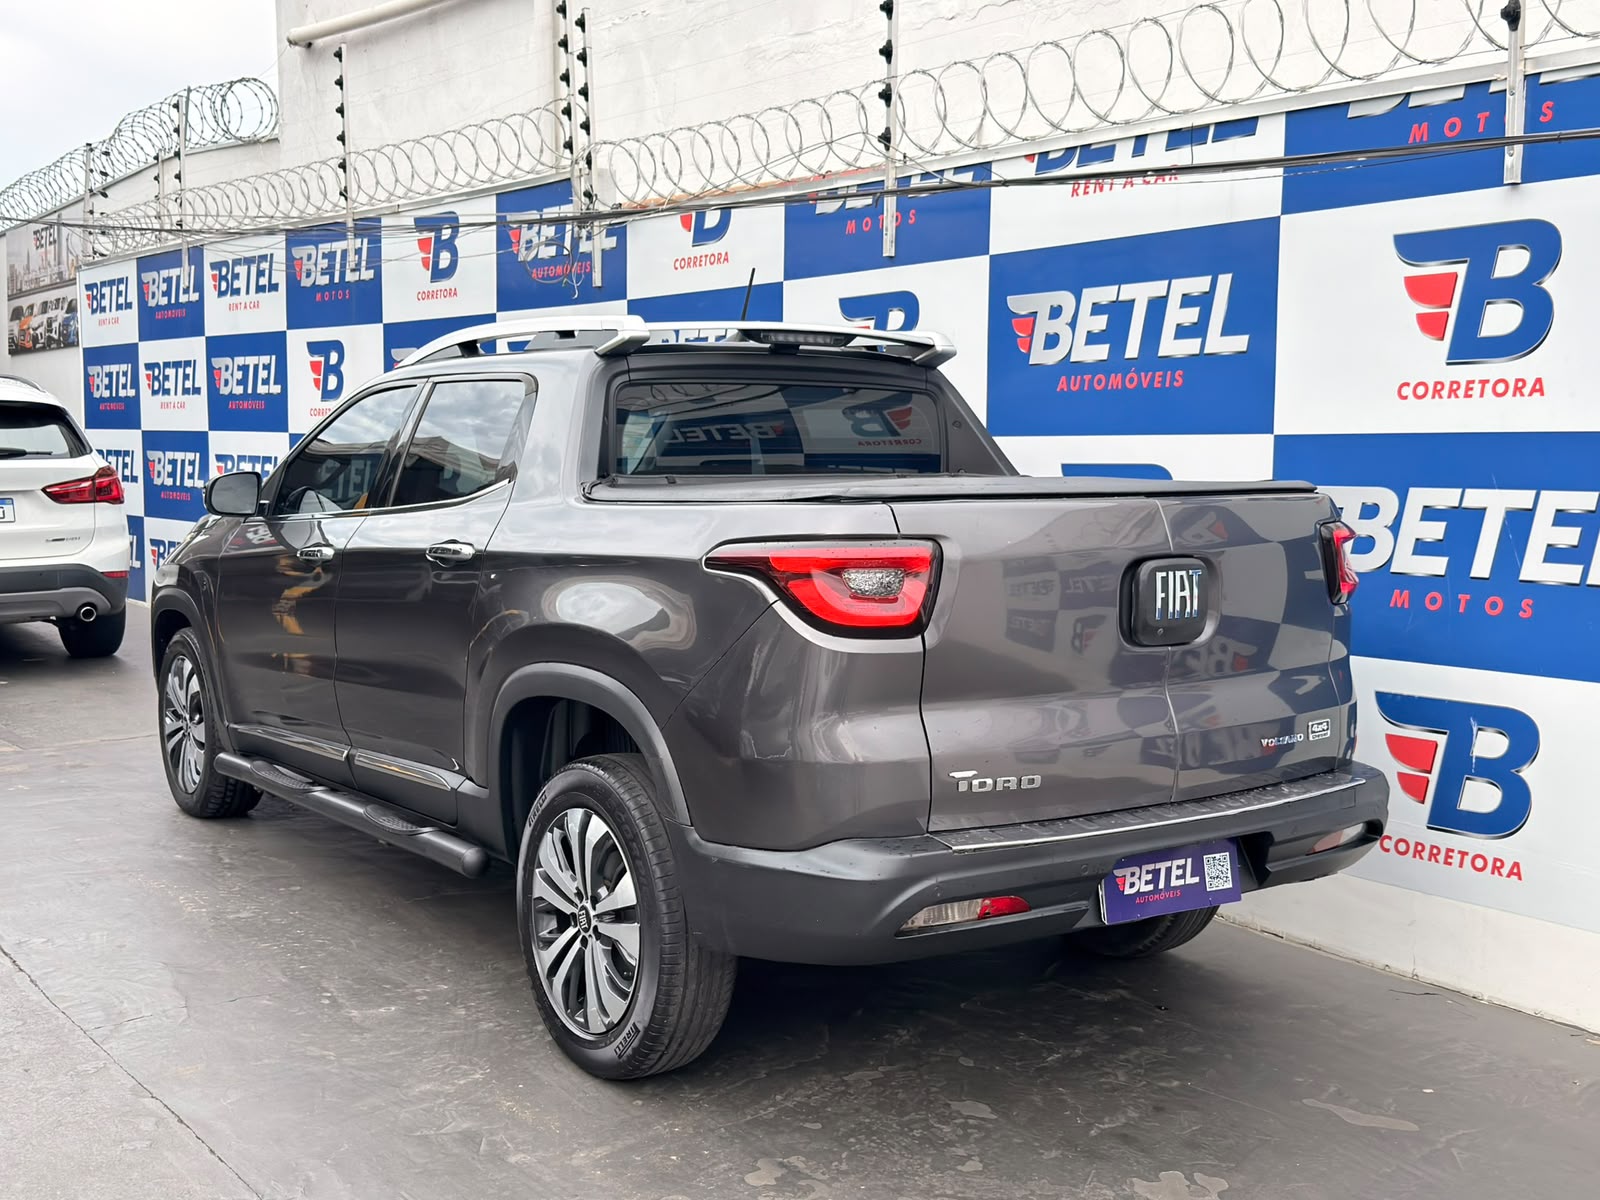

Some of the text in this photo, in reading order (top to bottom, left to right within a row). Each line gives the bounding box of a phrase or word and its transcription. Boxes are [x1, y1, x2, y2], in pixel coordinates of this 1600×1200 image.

[1408, 101, 1554, 144] MOTS
[209, 253, 279, 299] BETEL
[291, 238, 375, 288] BETEL
[673, 251, 729, 271] CORRETORA
[84, 276, 133, 315] BETEL
[315, 289, 351, 302] MOTOS
[416, 287, 458, 301] CORRETORA
[1006, 272, 1250, 366] BETEL
[87, 363, 136, 399] BETEL
[144, 359, 202, 397] BETEL
[211, 355, 282, 395] BETEL
[1056, 367, 1184, 392] AUTOMÓVEIS
[1396, 377, 1546, 401] CORRETORA
[95, 449, 138, 484] TEL
[146, 450, 205, 488] BETEL
[1316, 486, 1600, 587] BETE
[1154, 569, 1202, 620] FIAT
[1389, 589, 1535, 619] MOTOS
[948, 770, 1041, 792] TORO
[1112, 857, 1200, 895] BETEL
[1378, 834, 1524, 881] CORRETORA
[1135, 888, 1182, 905] AUTOMÓVEIS
[578, 910, 589, 929] FIAT
